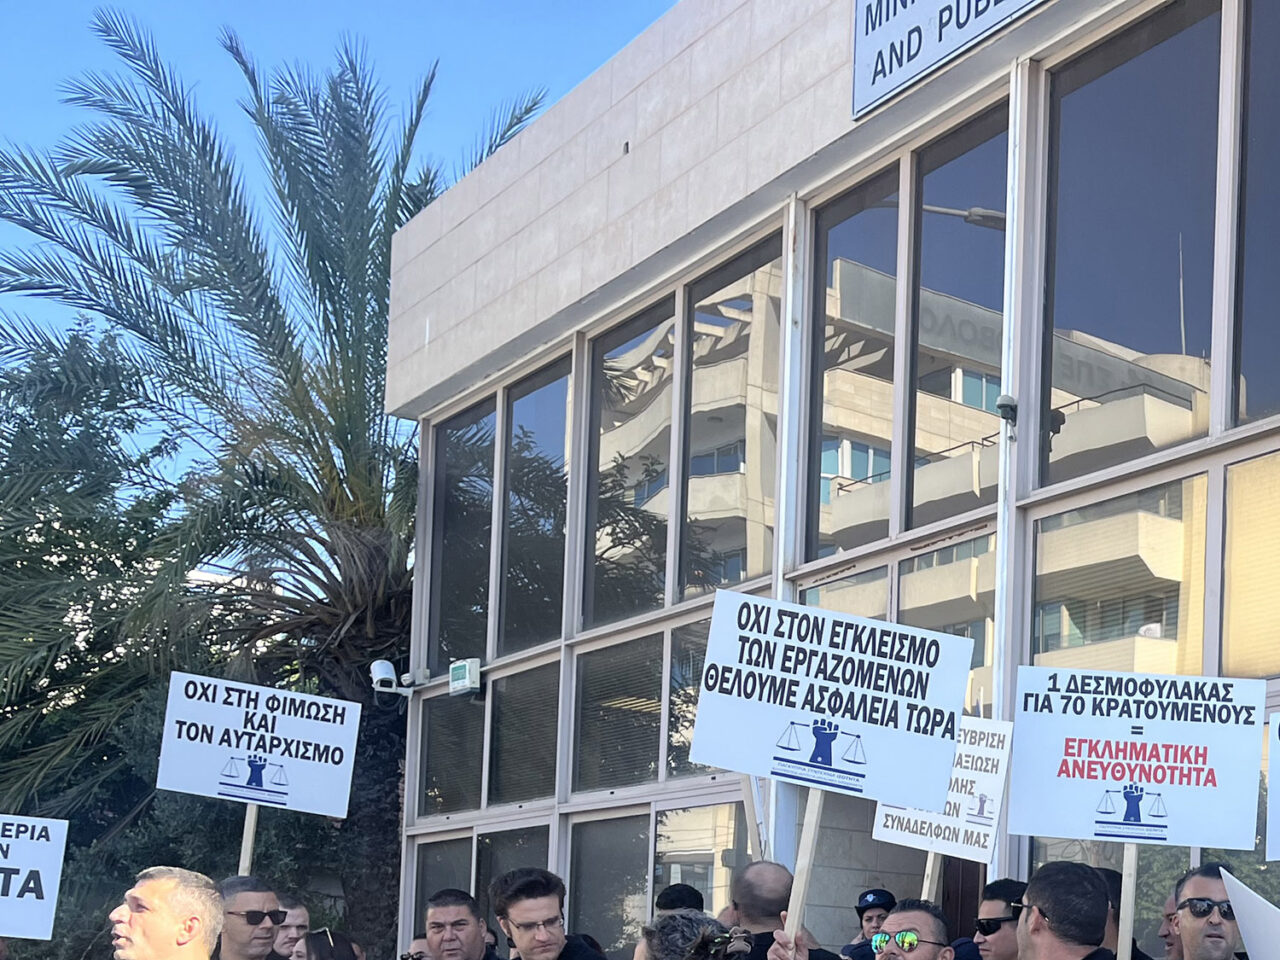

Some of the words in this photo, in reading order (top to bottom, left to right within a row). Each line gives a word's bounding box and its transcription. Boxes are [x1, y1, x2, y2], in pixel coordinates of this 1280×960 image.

[871, 25, 922, 85] AND
[737, 601, 771, 635] ΟΧΙ
[773, 608, 826, 645] ΣΤΟΝ
[828, 619, 940, 668] ΕΓΚΛΕΙΣΜΟ
[738, 635, 777, 670] ΤΩΝ
[780, 645, 930, 700] ΕΡΓΑΖΟΜΕΝΩΝ
[184, 680, 218, 703] ΟΧΙ
[222, 686, 259, 710] ΣΤΗ
[265, 694, 346, 725] ΦΙΜΩΣΗ
[704, 662, 801, 709] ΘΕΛΟΥΜΕ
[801, 683, 899, 729] ΑΣΦΑΛΕΙΑ
[905, 702, 956, 740] ΤΩΡΑ
[1047, 673, 1061, 693] 1
[1065, 674, 1234, 702] ΔΕΣΜΟΦΥΛΑΚΑΣ
[243, 711, 277, 734] ΚΑΙ
[1022, 692, 1053, 713] ΓΙΑ
[1060, 694, 1085, 716] 70
[1091, 697, 1256, 725] ΚΡΑΤΟΥΜΕΝΟΥΣ
[175, 720, 214, 744] ΤΟΝ
[218, 728, 344, 765] ΑΥΤΑΡΧΙΣΜΟ
[1063, 737, 1208, 766] ΕΓΚΛΗΜΑΤΙΚΗ
[952, 751, 1000, 774] ΑΞΙΩΣΗ
[1057, 759, 1217, 788] ΑΝΕΥΘΥΝΟΤΗΤΑ
[0, 822, 51, 842] ΕΡΙΑ
[883, 813, 960, 843] ΣΥΝΑΔΕΛΦΩΝ
[962, 829, 990, 849] ΜΑΣ
